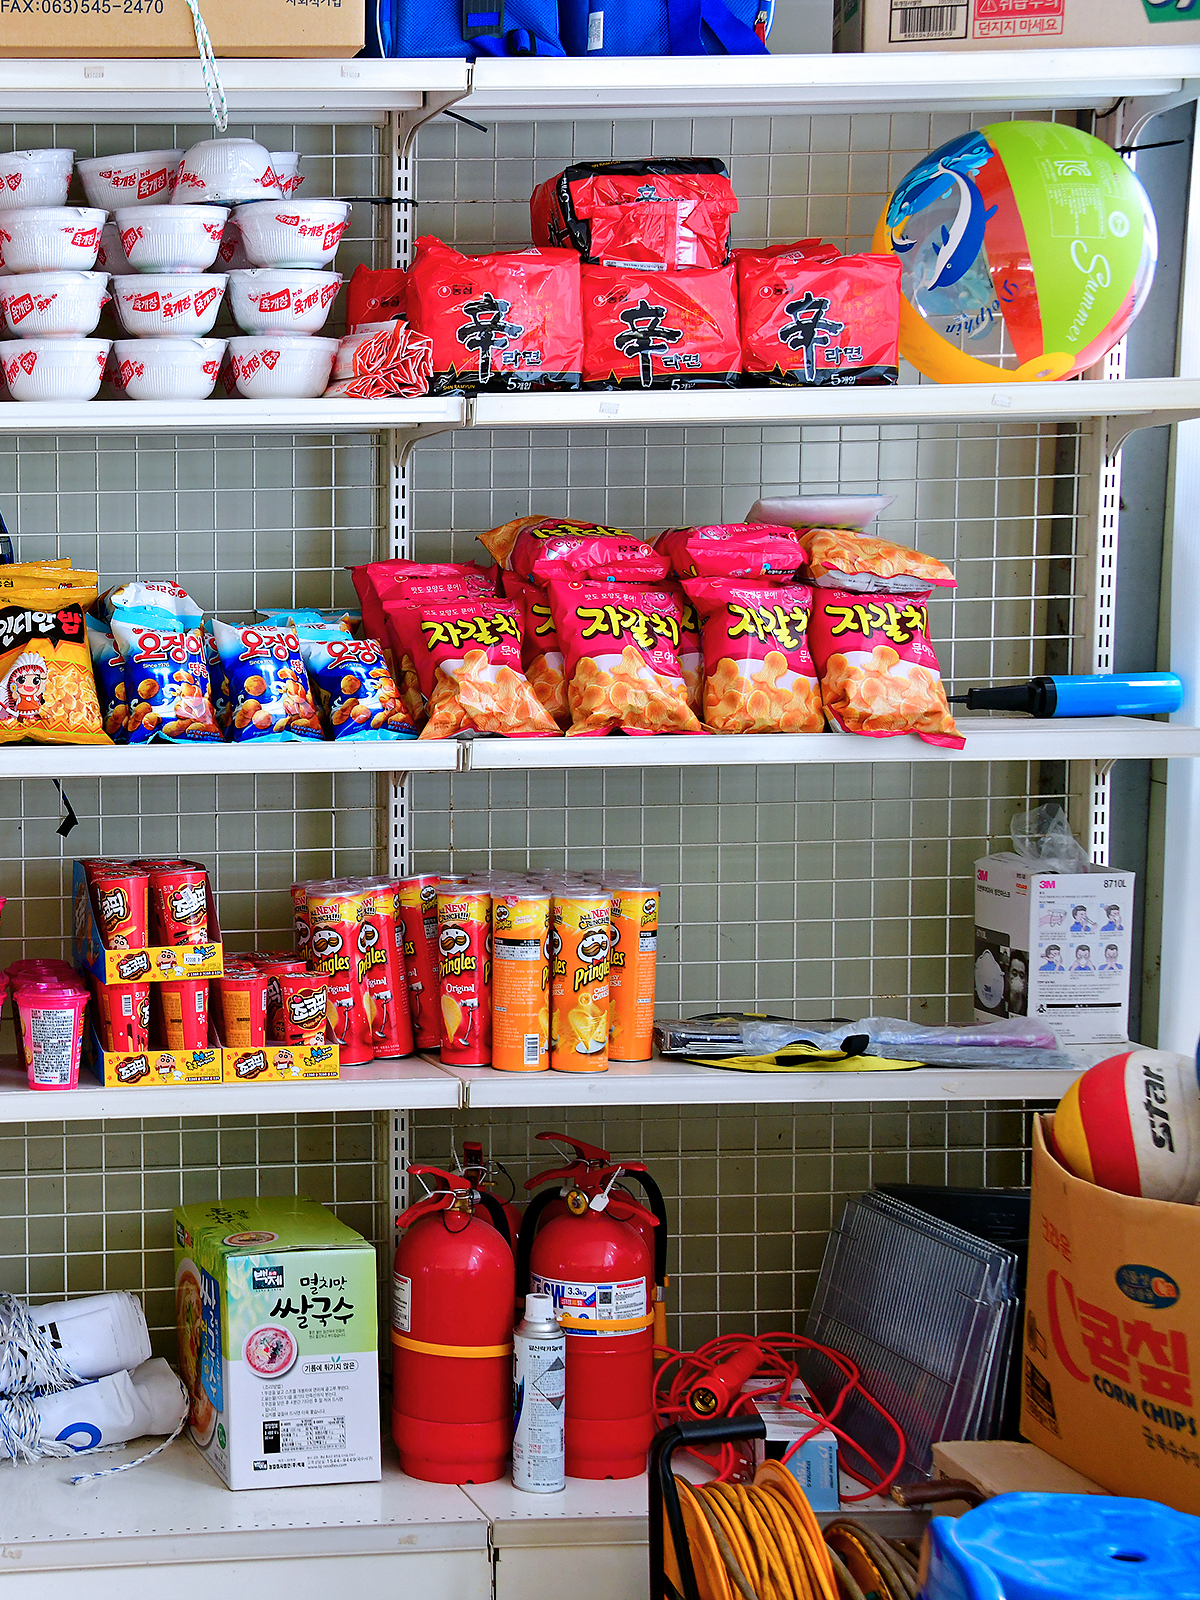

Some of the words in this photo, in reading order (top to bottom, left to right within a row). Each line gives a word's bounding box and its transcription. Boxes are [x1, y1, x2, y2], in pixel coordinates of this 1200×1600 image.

[979, 20, 1016, 36] 던지지
[1019, 18, 1058, 33] 마세요
[260, 291, 290, 311] 육개장
[452, 285, 472, 295] 농심
[1065, 239, 1111, 342] Summer
[12, 295, 34, 322] 육개장
[163, 293, 192, 317] 육개장
[293, 290, 320, 316] 육개장
[945, 279, 1019, 336] Dolphin
[456, 292, 525, 384] 辛
[614, 299, 683, 387] 辛
[779, 291, 845, 382] 辛
[502, 350, 542, 368] 라면
[662, 353, 701, 370] 라면
[824, 346, 864, 365] 라면
[507, 378, 532, 391] 5개입
[421, 613, 522, 651] 자갈치
[576, 605, 680, 649] 자갈치
[825, 602, 927, 643] 자갈치
[977, 869, 989, 881] 3M
[1039, 880, 1056, 889] 3M
[1103, 880, 1127, 888] 8710L
[316, 904, 340, 914] NEW
[445, 903, 468, 914] NEW
[580, 914, 591, 922] ALL
[591, 908, 609, 919] NEW
[119, 953, 148, 978] 초코픽
[439, 953, 477, 978] Pringles
[574, 961, 610, 992] Pringle
[327, 983, 350, 993] riginal
[445, 984, 475, 994] Original
[291, 988, 327, 1021] 초코픽
[118, 1054, 147, 1080] 초코픽
[236, 1050, 265, 1076] 초코픽
[1142, 1065, 1175, 1153] STAR
[254, 1269, 282, 1286] 백제
[300, 1273, 348, 1295] 멸치맛
[567, 1286, 587, 1298] 3.3kg
[270, 1295, 354, 1330] 쌀국수
[305, 1364, 322, 1373] 기름에
[324, 1363, 341, 1372] 튀기지
[343, 1362, 355, 1370] 않은
[1093, 1374, 1138, 1412] CORN
[1142, 1398, 1197, 1436] CHIPS
